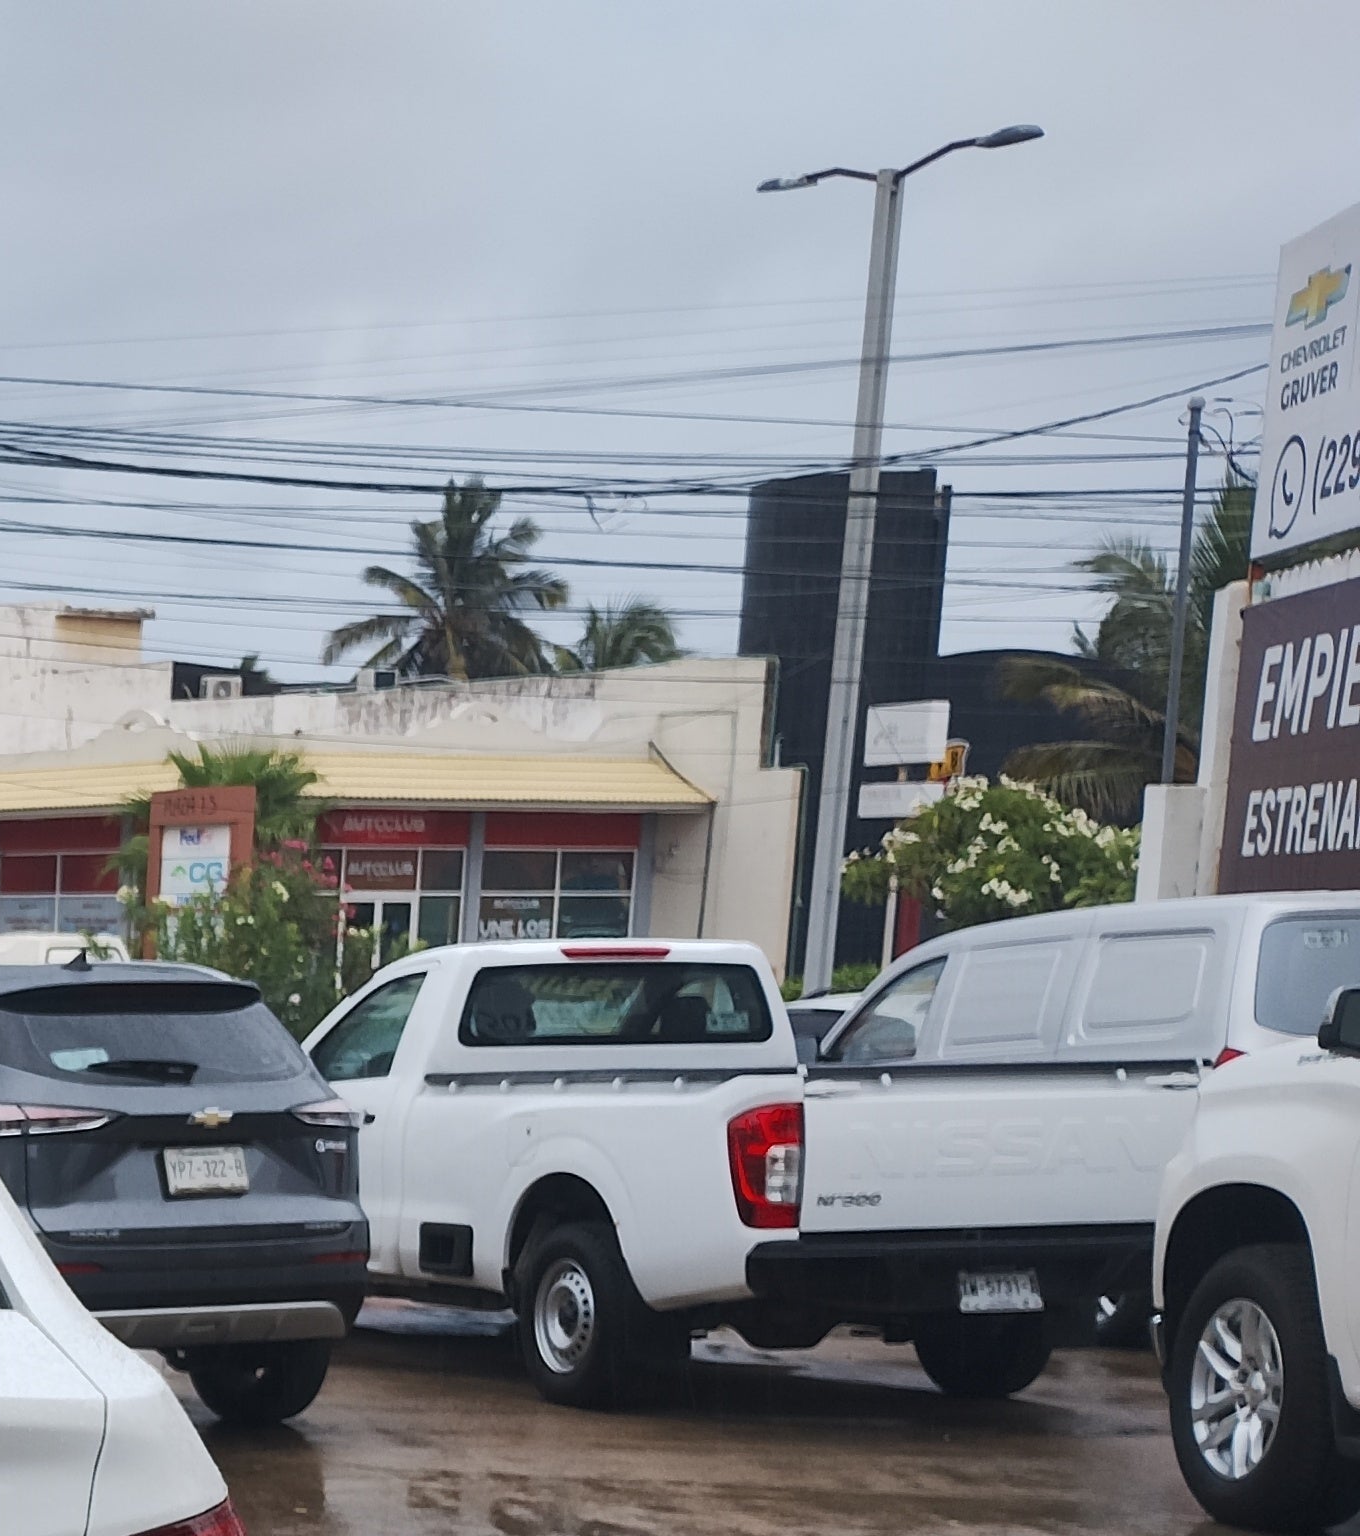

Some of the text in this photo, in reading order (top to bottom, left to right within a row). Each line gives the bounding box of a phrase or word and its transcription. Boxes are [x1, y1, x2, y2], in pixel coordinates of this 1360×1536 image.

[1281, 325, 1348, 374] CHEVROLET
[1281, 361, 1339, 411] GRUVER
[1241, 779, 1360, 858] ESTRENA
[189, 862, 223, 883] CG
